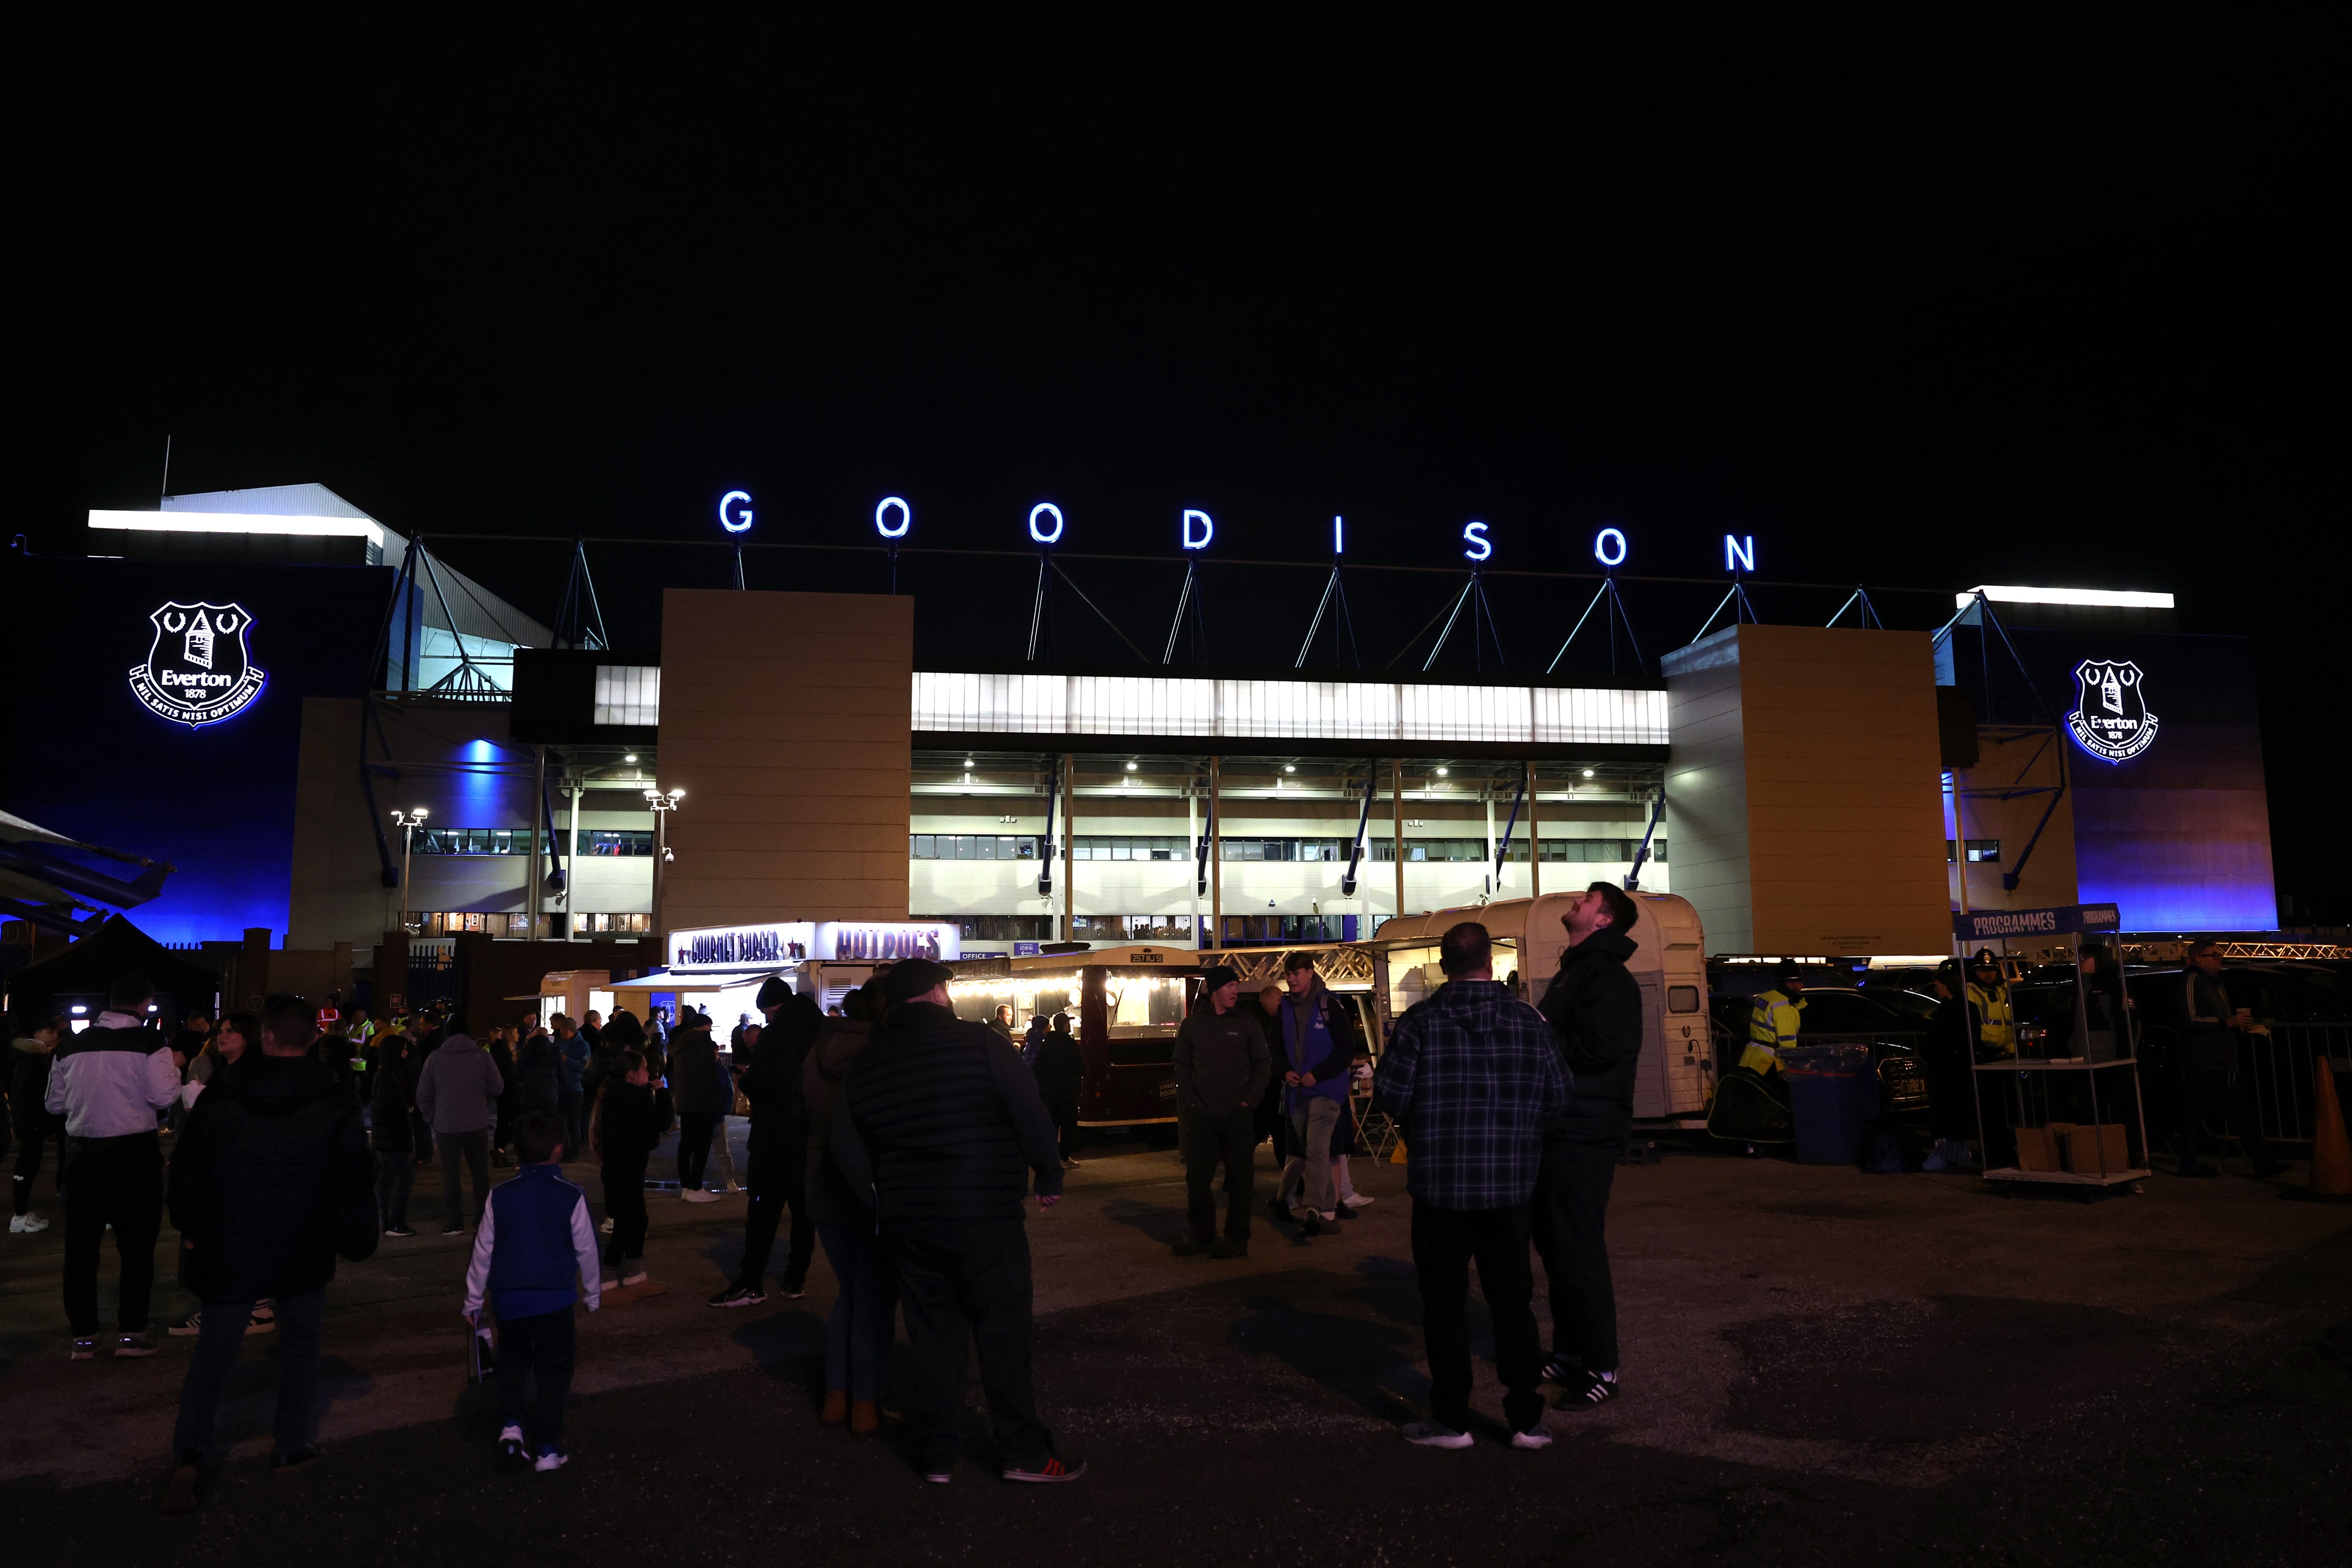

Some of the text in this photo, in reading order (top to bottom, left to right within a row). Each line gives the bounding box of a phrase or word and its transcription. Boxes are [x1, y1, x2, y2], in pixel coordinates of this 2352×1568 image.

[718, 490, 1755, 573] GOODISON
[162, 670, 231, 687] Everton
[136, 683, 255, 720] NIL SATIS NISI OPTIMUM
[184, 689, 206, 699] 1878
[2076, 726, 2086, 741] NIL
[2087, 740, 2107, 755] SATIS
[2127, 727, 2154, 755] OPTIMUM
[1974, 912, 2055, 936] PROGRAMMES
[2083, 910, 2116, 924] PROGRAMMES
[691, 930, 779, 964] GOURMET BURGER
[837, 928, 939, 958] HOT DOGS
[1159, 1089, 1177, 1097] FOOD
